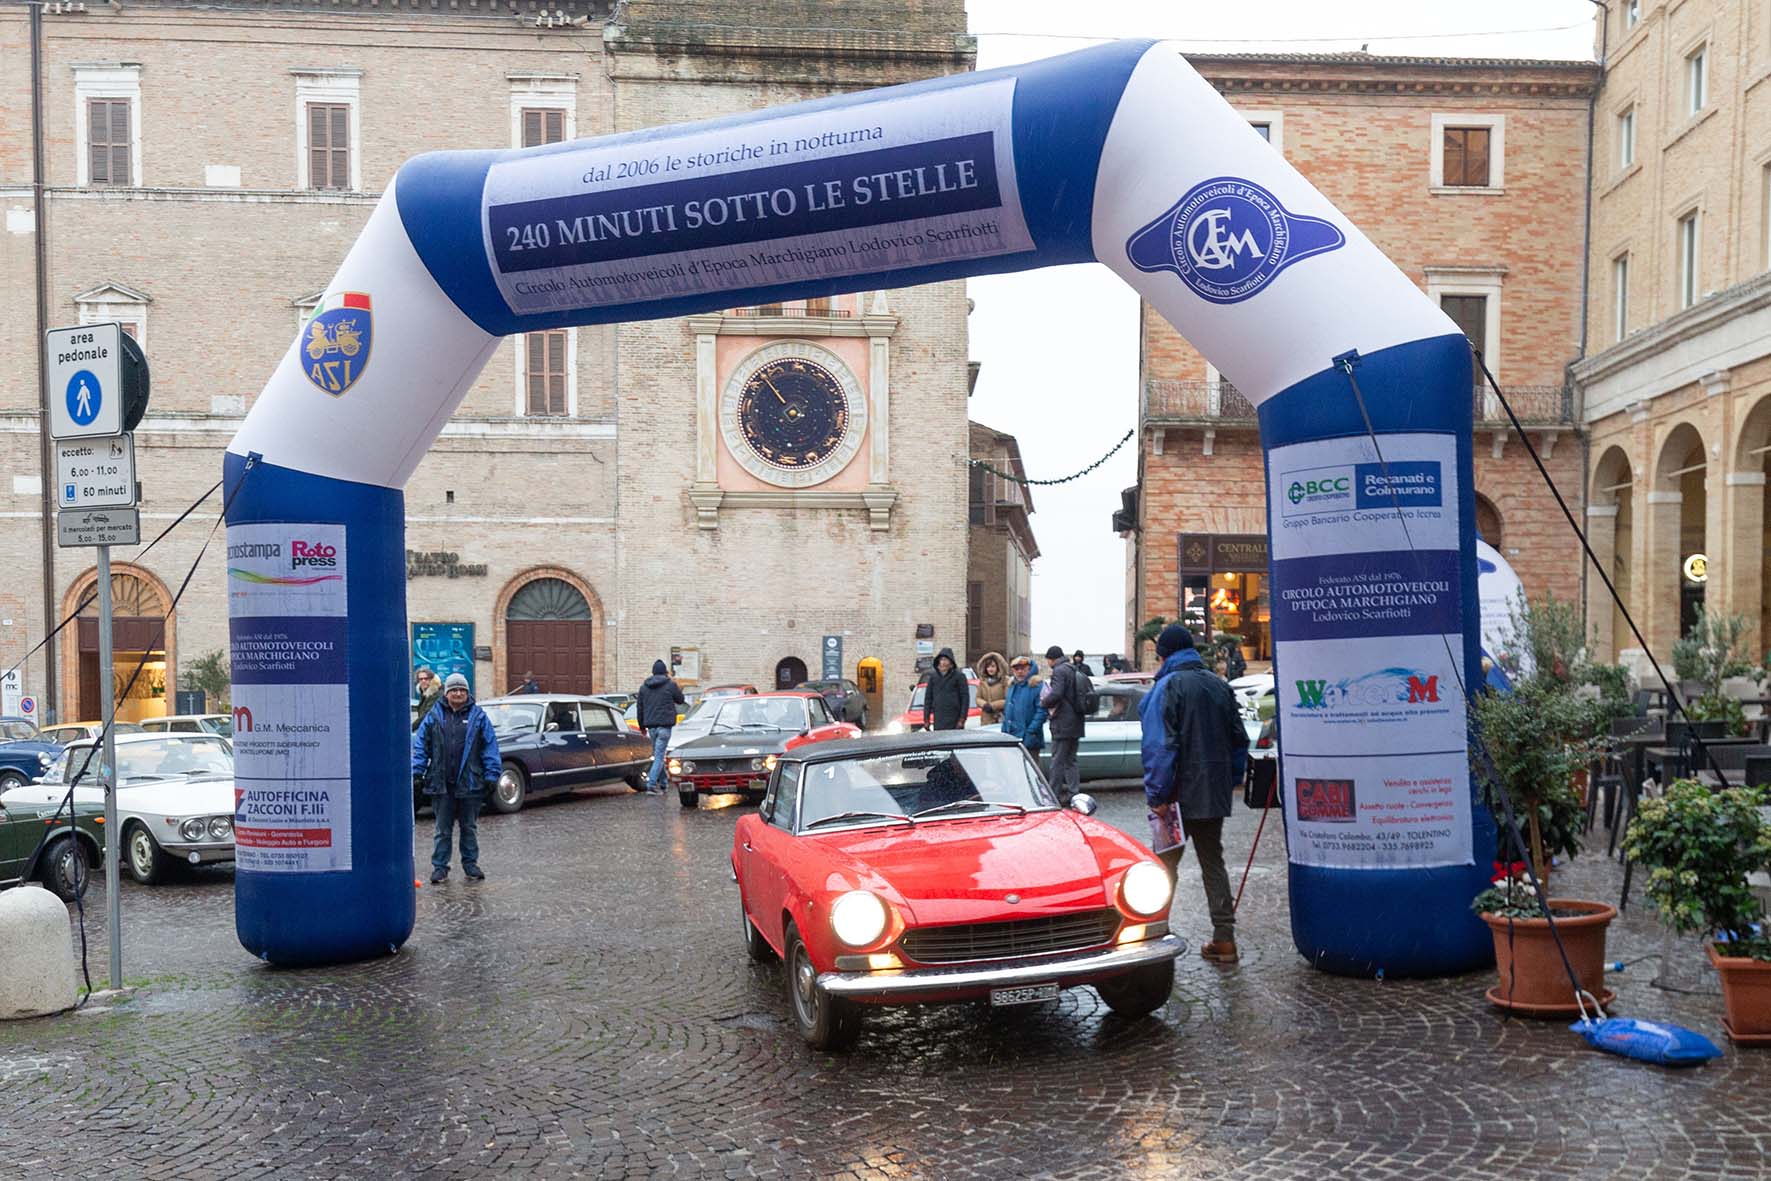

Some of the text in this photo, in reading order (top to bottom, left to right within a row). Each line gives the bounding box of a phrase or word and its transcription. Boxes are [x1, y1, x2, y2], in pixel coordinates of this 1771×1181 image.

[582, 126, 884, 184] dal 2006 le storiche in notturna
[506, 159, 979, 252] 240 MINUTI SOTTO LE STELLE
[1267, 207, 1287, 266] Marchigiano
[515, 220, 1000, 296] Circolo Automotoveicoli d'Epoca Marchigiano Lodovico Scarfiotti
[70, 333, 95, 345] area
[58, 346, 108, 365] pedonale
[61, 447, 95, 458] eccetto:
[1306, 477, 1350, 495] BCC
[1364, 472, 1435, 486] Recanati e
[83, 485, 127, 497] 60 minuti
[1364, 486, 1436, 497] Colmurano
[107, 523, 133, 532] mercato
[1282, 517, 1311, 531] Gruppo
[1311, 514, 1351, 527] Bancario
[1353, 510, 1415, 524] Cooperativo
[291, 540, 337, 558] Roto
[291, 556, 337, 570] press
[1352, 573, 1368, 583] ASI
[1368, 572, 1382, 583] dal
[1281, 580, 1450, 601] CIRCOLO AUTOMOTOVEICOLI
[1291, 593, 1438, 612] D'EPOCA MARCHIGIANO
[1312, 607, 1412, 623] Lodovico Scarfiotti
[240, 641, 334, 651] AUTOMOTOVEICOLI
[246, 651, 320, 661] MARCHIGIANO
[258, 660, 296, 671] Scarfiotti
[254, 724, 274, 733] G.M.
[276, 723, 331, 733] Meccanica
[823, 765, 836, 779] 1
[247, 790, 330, 802] AUTOFFICINA
[247, 803, 298, 815] ZACCONI
[1407, 829, 1452, 840] TOLENTINO
